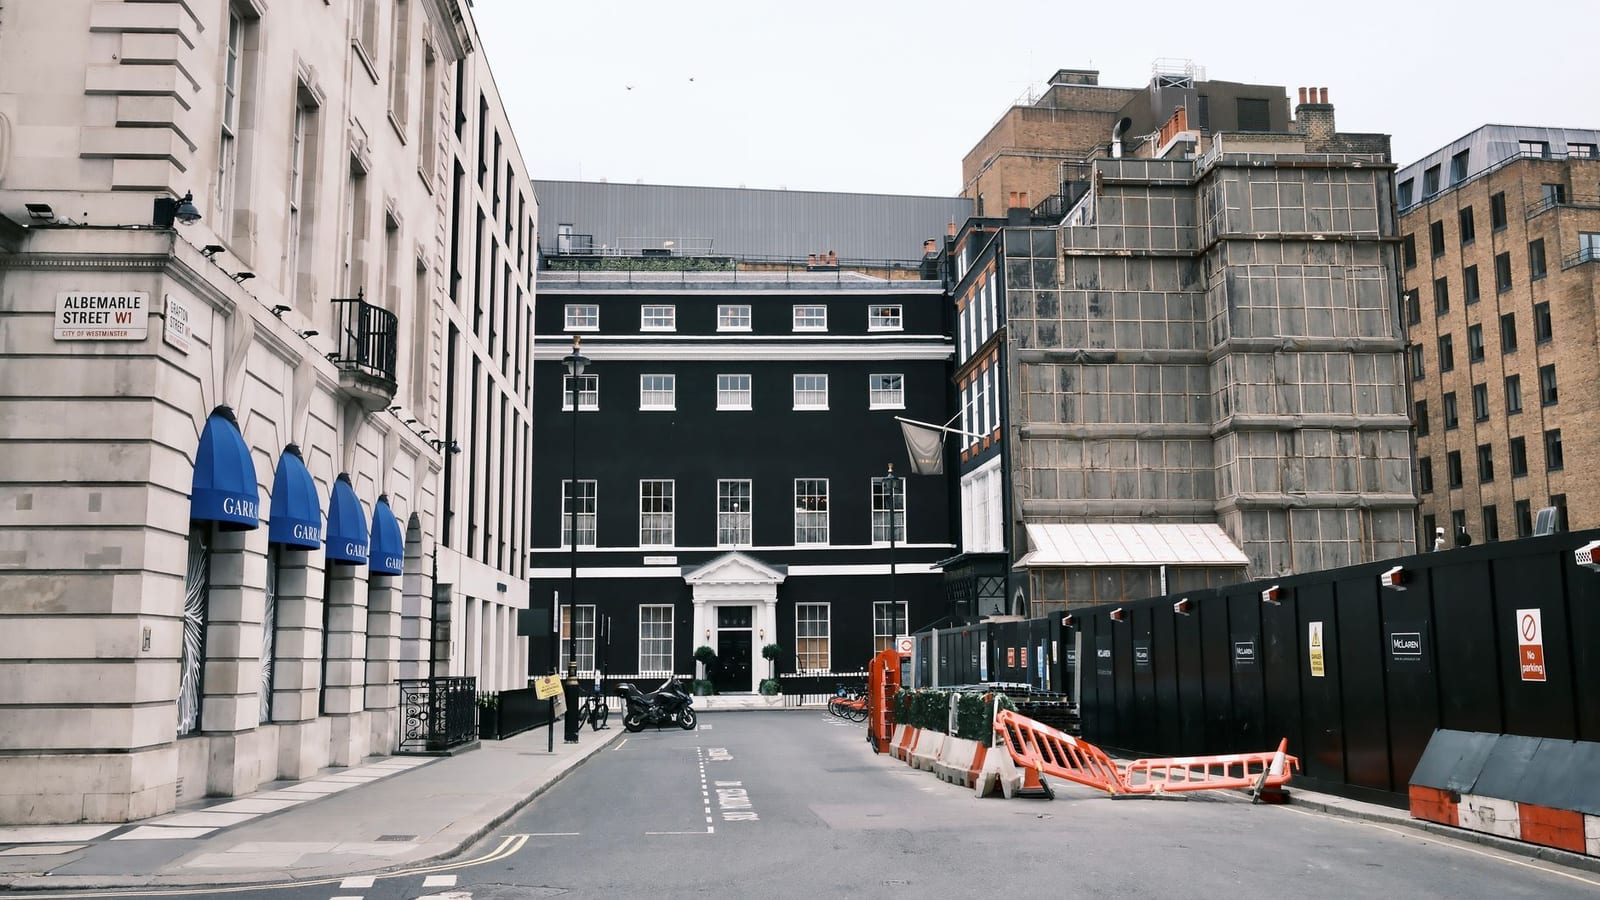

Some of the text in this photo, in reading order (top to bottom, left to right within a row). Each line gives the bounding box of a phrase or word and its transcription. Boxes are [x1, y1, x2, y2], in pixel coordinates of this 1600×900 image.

[64, 296, 141, 309] ALBEMARLE
[62, 311, 132, 324] STREET W1
[169, 315, 185, 335] STREET
[1526, 650, 1536, 660] No
[1522, 663, 1543, 675] parking
